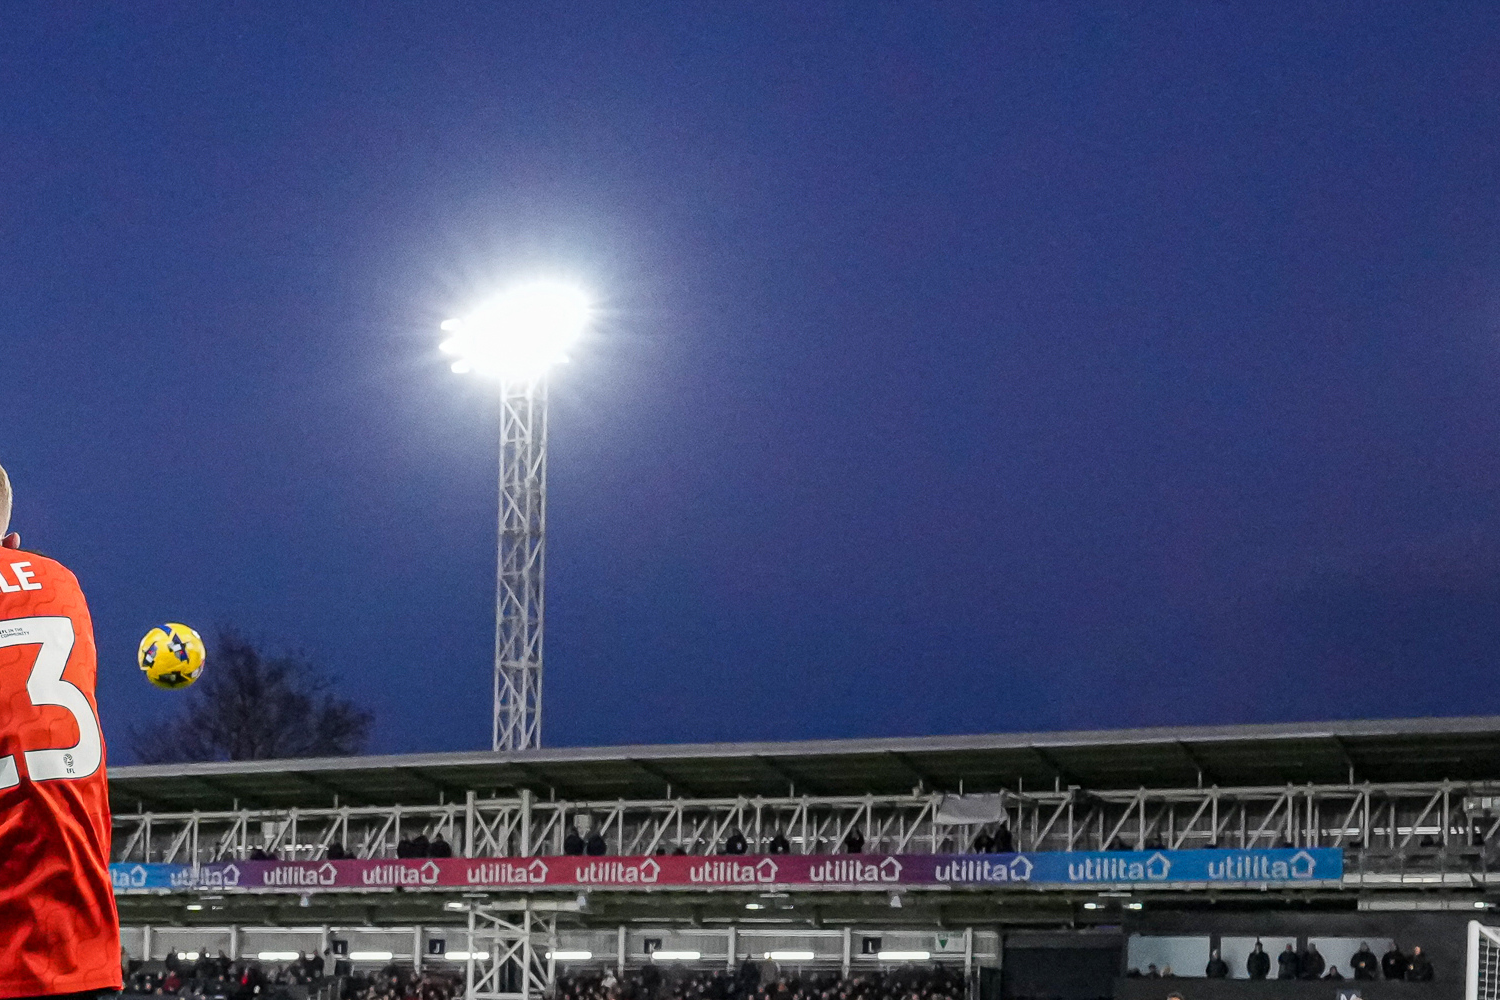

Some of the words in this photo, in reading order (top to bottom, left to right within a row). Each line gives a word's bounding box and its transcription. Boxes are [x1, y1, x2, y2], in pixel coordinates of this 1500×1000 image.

[263, 866, 318, 886] utilita
[362, 865, 420, 885] utilita
[467, 863, 528, 884] utilita
[576, 862, 639, 883] utilita
[690, 861, 755, 882] utilita
[810, 860, 879, 882] utilita
[935, 860, 1008, 882] utilita
[1068, 858, 1144, 881] utilita
[1208, 856, 1288, 880] utilita
